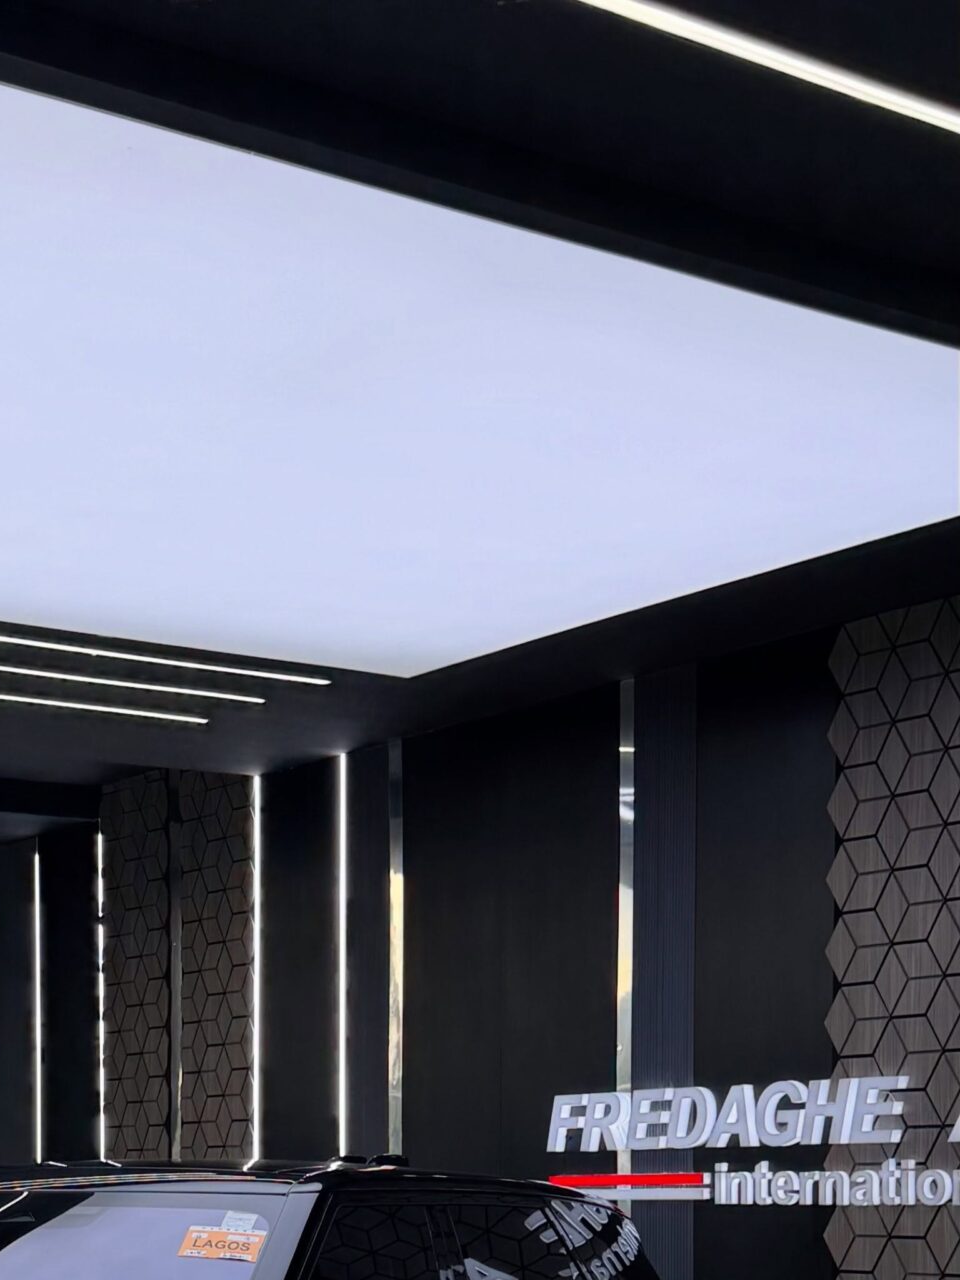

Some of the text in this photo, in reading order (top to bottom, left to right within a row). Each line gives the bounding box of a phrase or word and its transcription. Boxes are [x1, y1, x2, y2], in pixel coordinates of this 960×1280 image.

[546, 1075, 910, 1152] FREDAGHE
[713, 1157, 960, 1207] internatio
[192, 1239, 251, 1252] LAGOS
